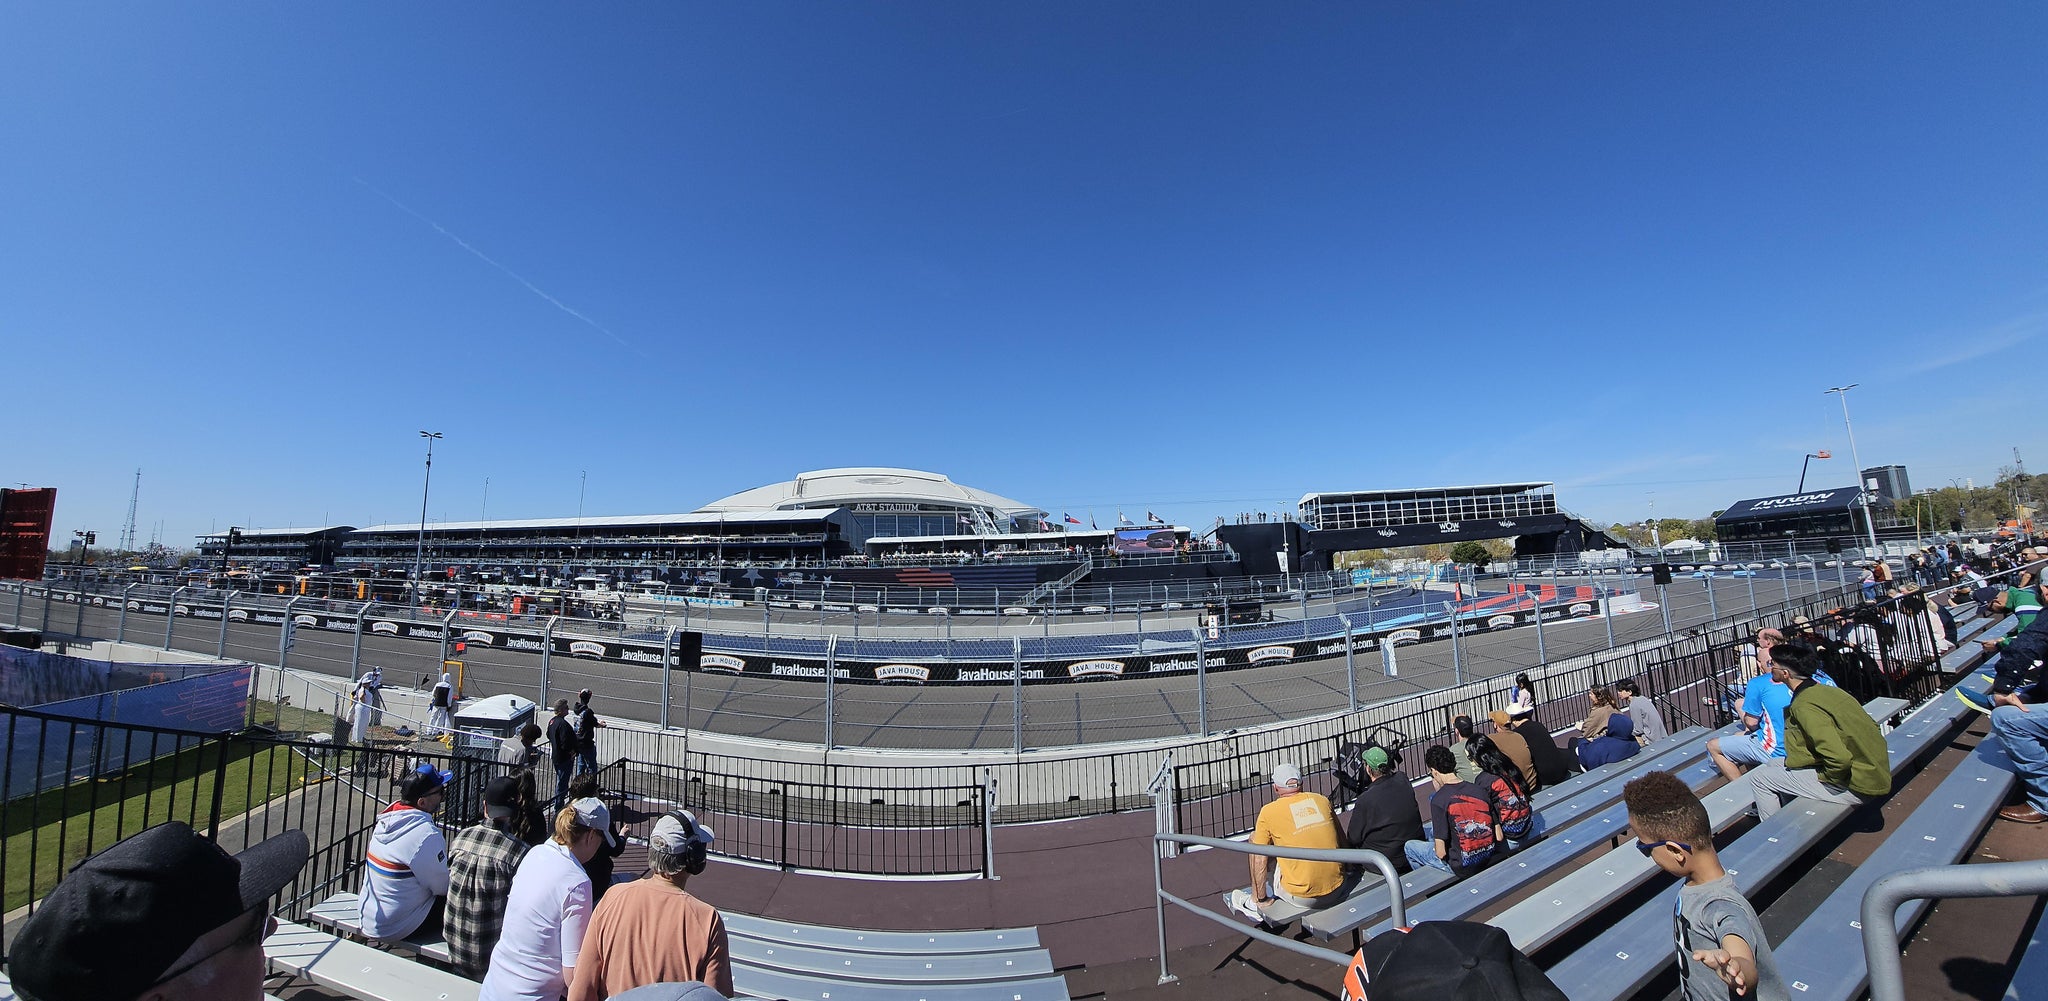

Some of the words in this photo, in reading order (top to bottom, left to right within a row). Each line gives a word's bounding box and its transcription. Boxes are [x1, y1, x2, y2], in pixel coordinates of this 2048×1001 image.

[855, 503, 877, 511] AT&T
[879, 503, 919, 511] STADIUM
[1438, 521, 1460, 530] WOW
[326, 619, 358, 631] JavaHouse.co
[1433, 623, 1478, 637] JavaHse.com
[409, 626, 446, 640] JavaHouse.c
[506, 636, 556, 651] JavaHouse.cm
[1317, 639, 1374, 656] JavaHoue.com
[620, 648, 680, 666] JavaHouse.m
[701, 656, 715, 664] JAVA
[719, 656, 742, 668] HOUSE
[1250, 650, 1265, 660] JAVA
[770, 662, 850, 678] JavaHouse.om
[878, 666, 897, 676] JAVA
[898, 665, 926, 677] HOUSE
[1072, 664, 1089, 674] JAVA
[1094, 662, 1120, 671] HOUSE
[1149, 657, 1226, 673] JavaHouscom
[956, 667, 1044, 681] JavaHousecom
